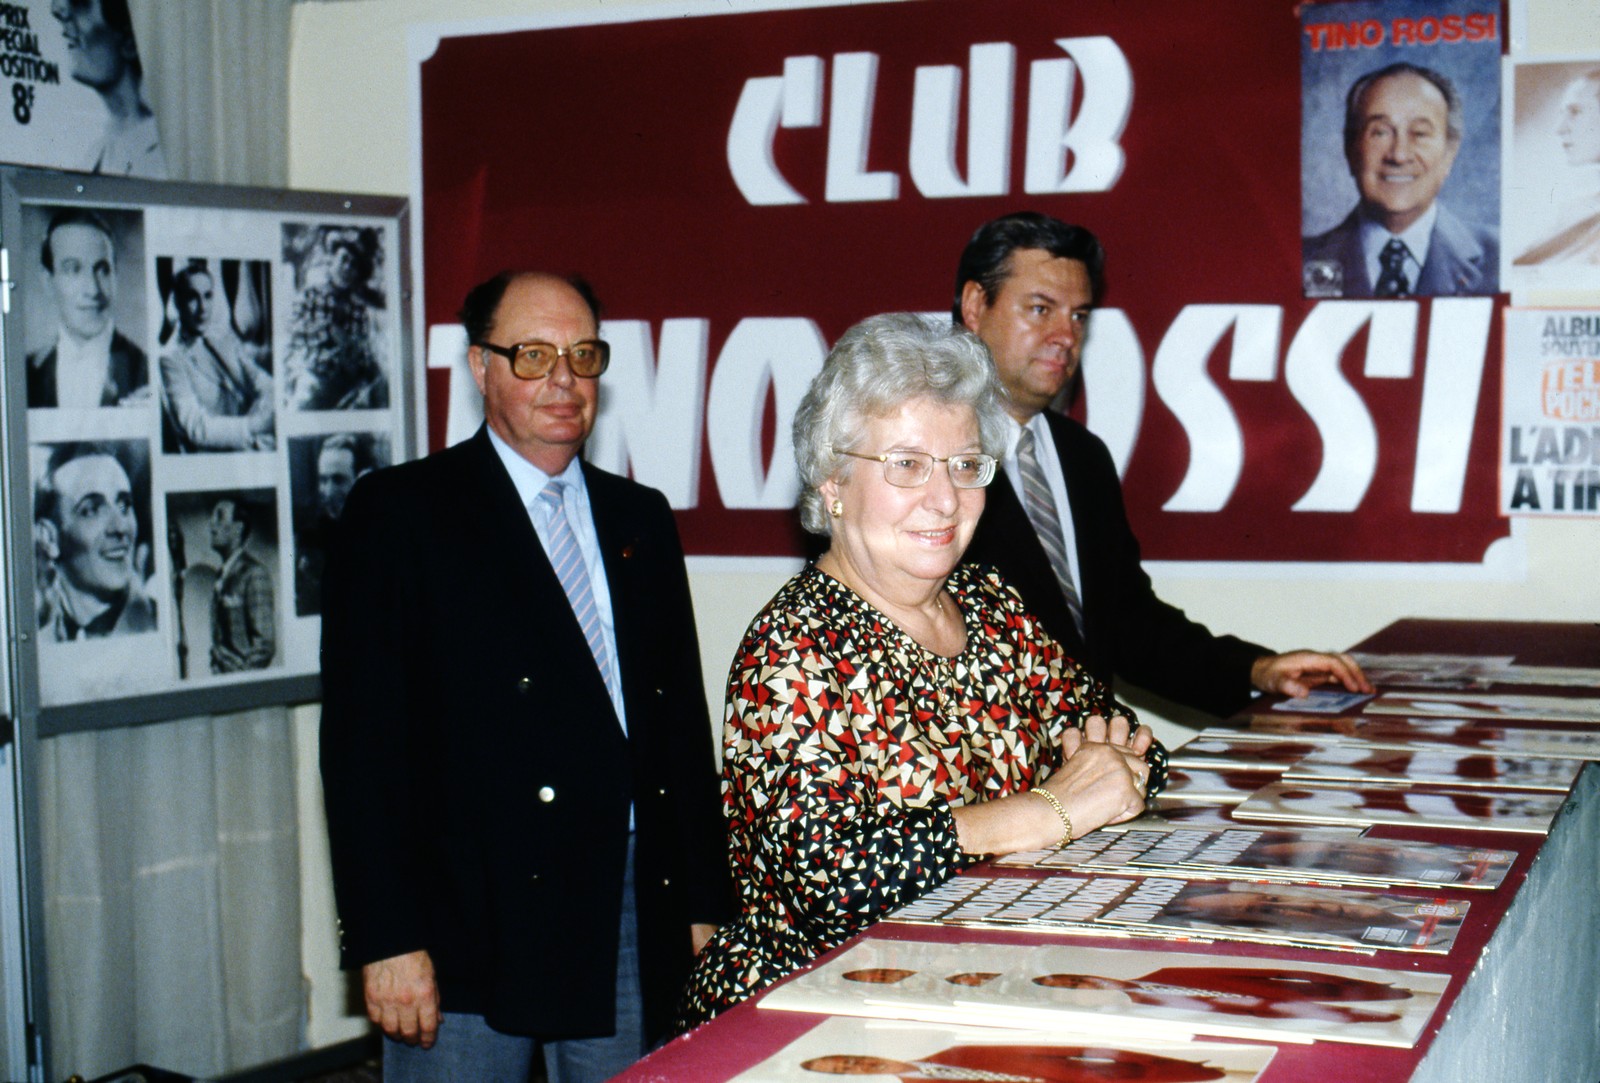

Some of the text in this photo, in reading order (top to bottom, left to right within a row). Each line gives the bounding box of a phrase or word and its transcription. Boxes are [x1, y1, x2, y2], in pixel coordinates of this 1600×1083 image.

[1305, 13, 1497, 50] TINO ROSSI
[726, 35, 1134, 206] CLUB
[1082, 297, 1494, 513] SSI
[1510, 468, 1541, 510] A
